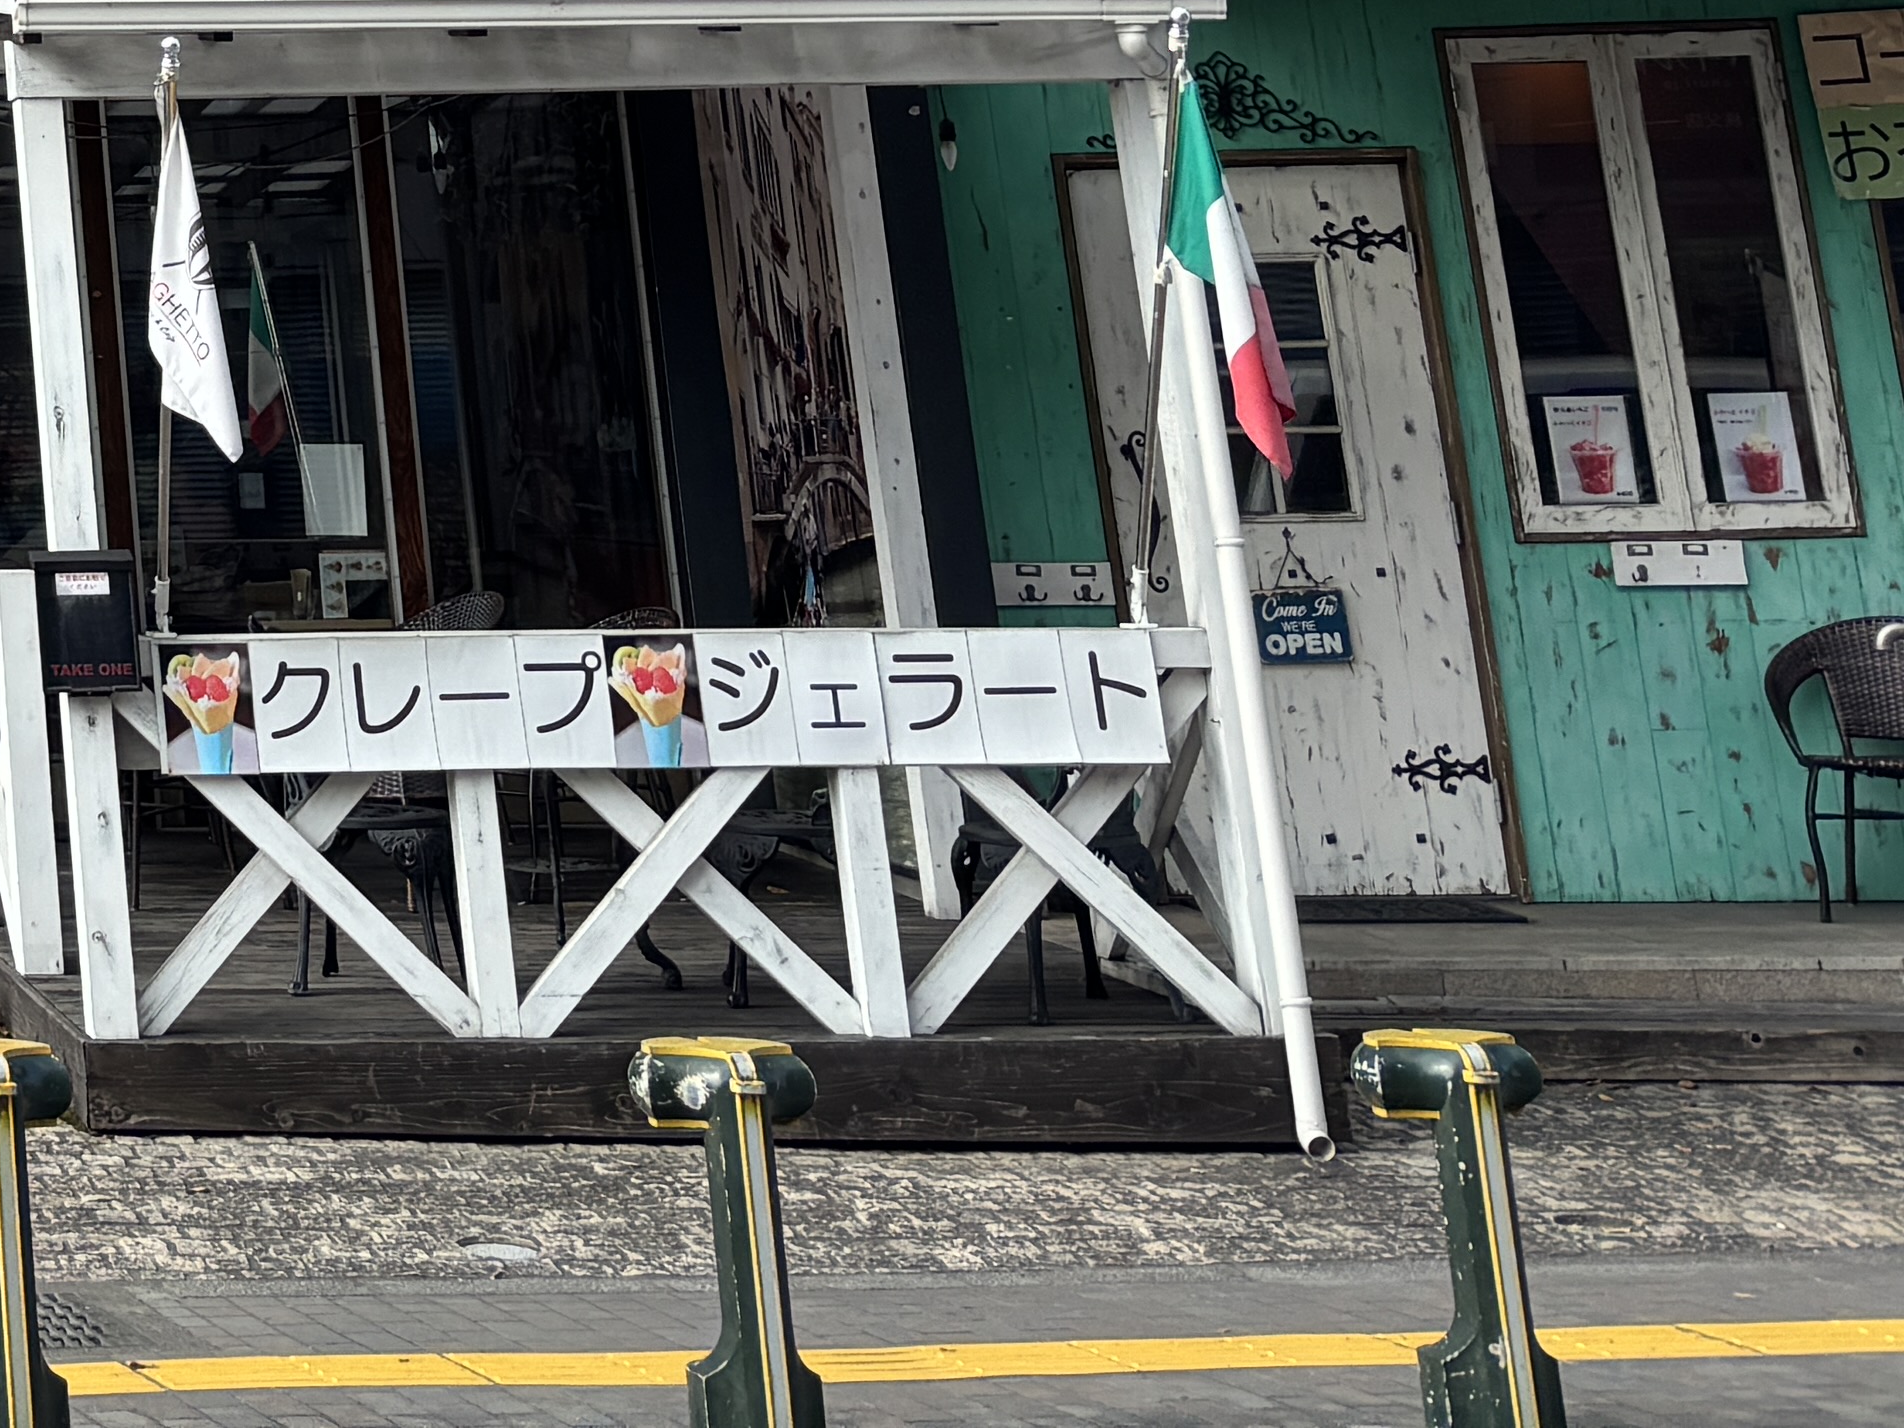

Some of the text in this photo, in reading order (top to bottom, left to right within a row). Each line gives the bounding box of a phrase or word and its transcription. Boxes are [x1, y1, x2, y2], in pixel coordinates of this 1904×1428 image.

[1828, 120, 1904, 183] お
[1262, 594, 1339, 621] Come In
[1281, 620, 1317, 632] WE'RE
[1265, 632, 1344, 656] OPEN
[52, 663, 134, 676] TAKE ONE
[262, 650, 1148, 739] クレープ ジェラート
